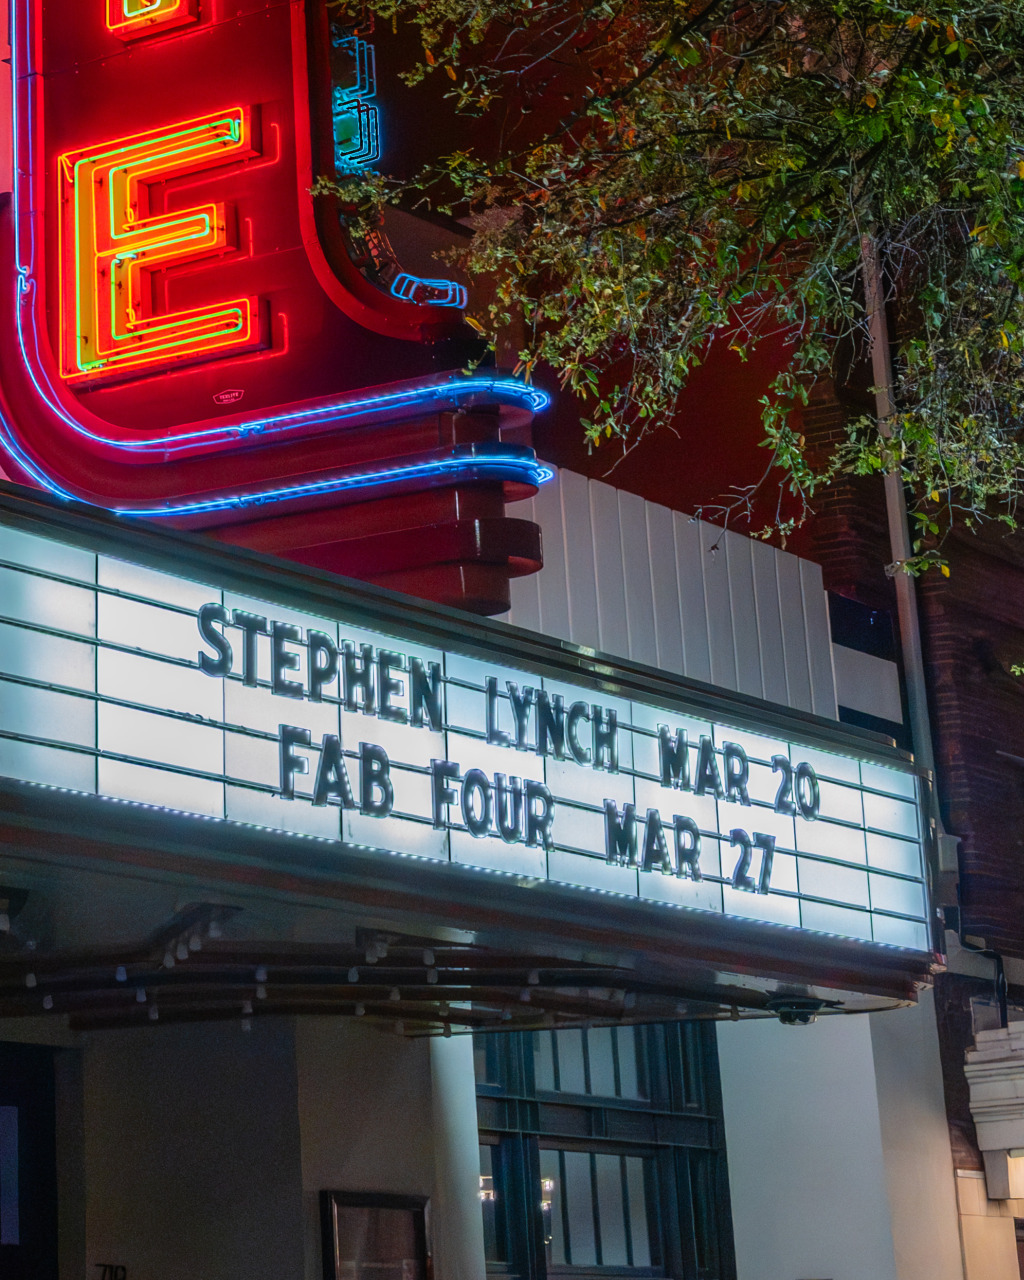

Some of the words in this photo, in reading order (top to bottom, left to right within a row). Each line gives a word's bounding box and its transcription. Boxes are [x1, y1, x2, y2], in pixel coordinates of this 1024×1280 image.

[198, 603, 443, 732] STEPHEN
[485, 675, 619, 774] LYNCH
[657, 723, 751, 806] MAR
[771, 754, 820, 821] 20
[278, 724, 394, 819] FAB
[430, 758, 556, 852] FOUR
[603, 798, 703, 882] MAR
[729, 828, 777, 895] 27
